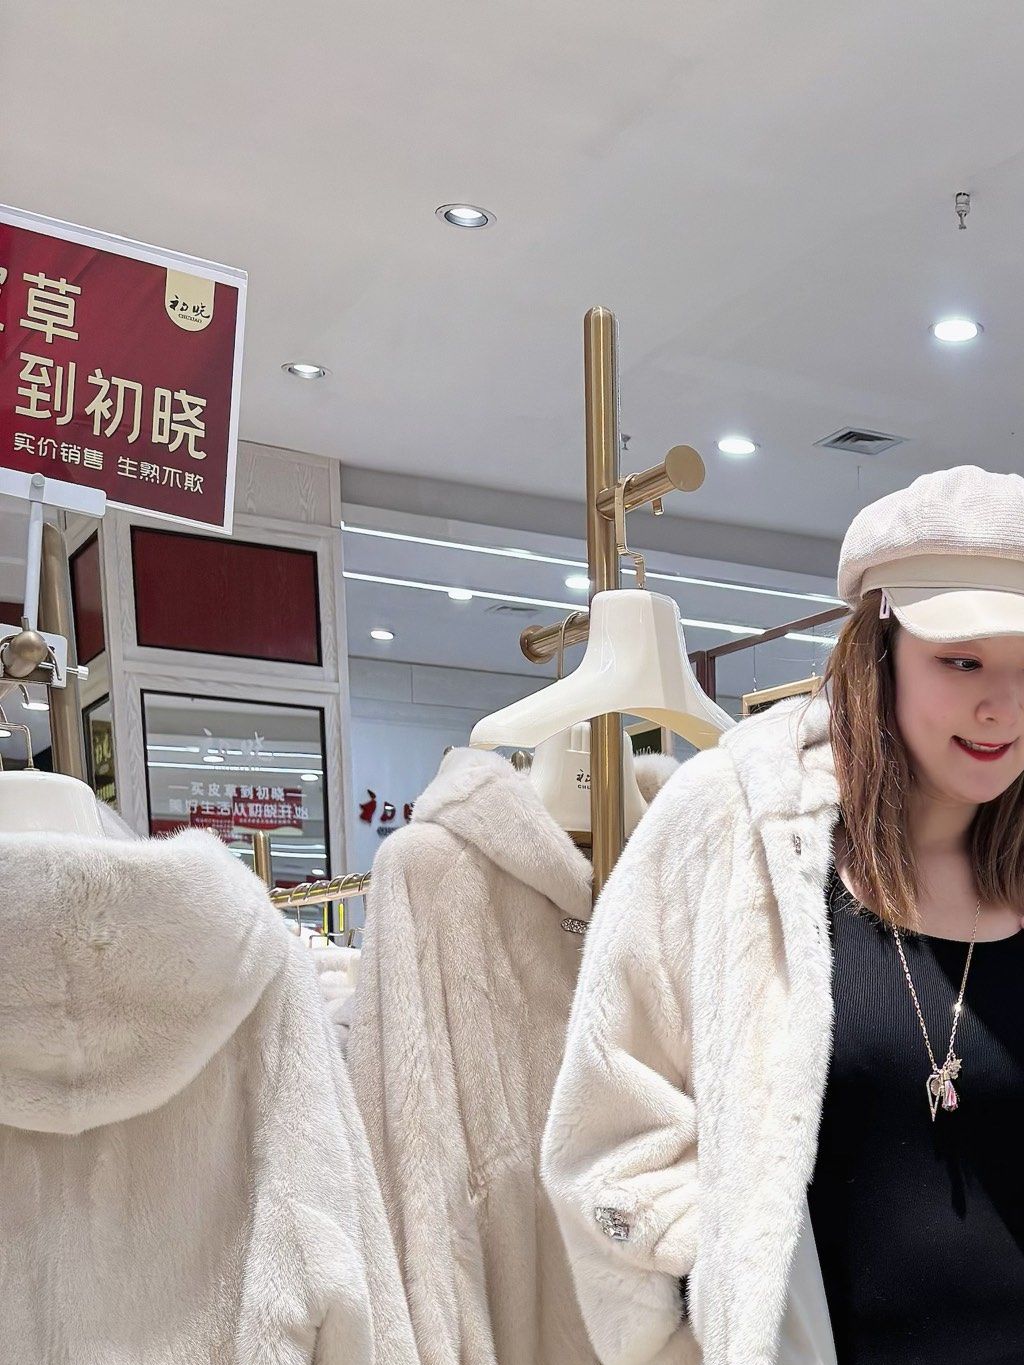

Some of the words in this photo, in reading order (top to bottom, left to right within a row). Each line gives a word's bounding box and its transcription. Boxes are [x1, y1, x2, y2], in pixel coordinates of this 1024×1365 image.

[0, 267, 81, 344] 草
[15, 351, 208, 461] 到初晓
[14, 432, 104, 471] 实价销售
[117, 456, 204, 494] 生熟不欺
